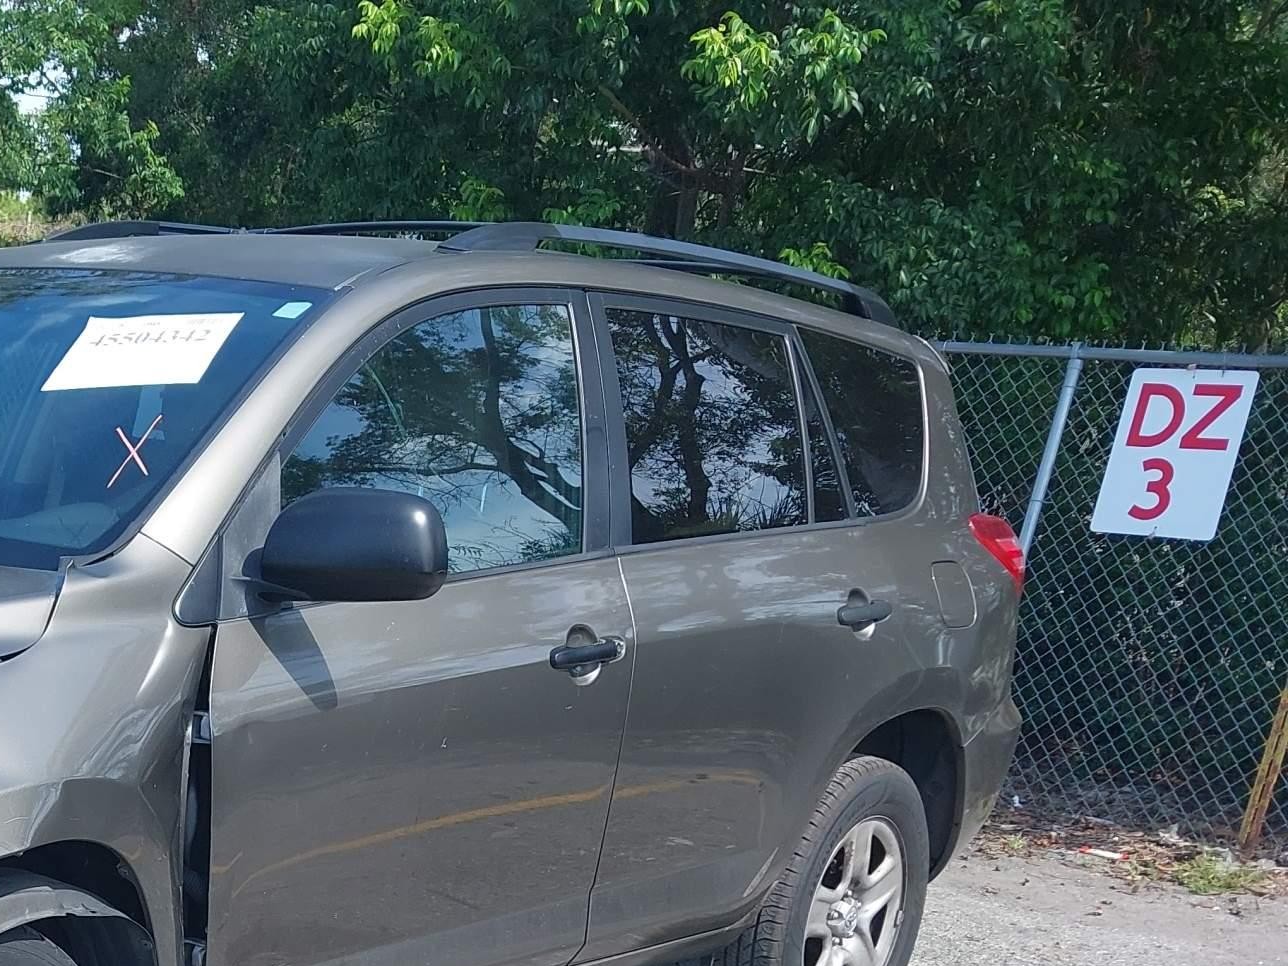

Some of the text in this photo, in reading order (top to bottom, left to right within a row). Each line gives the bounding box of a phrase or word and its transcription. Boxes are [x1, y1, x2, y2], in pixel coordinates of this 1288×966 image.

[89, 329, 211, 346] 45504342
[1125, 383, 1244, 451] DZ
[1127, 457, 1175, 521] 3
